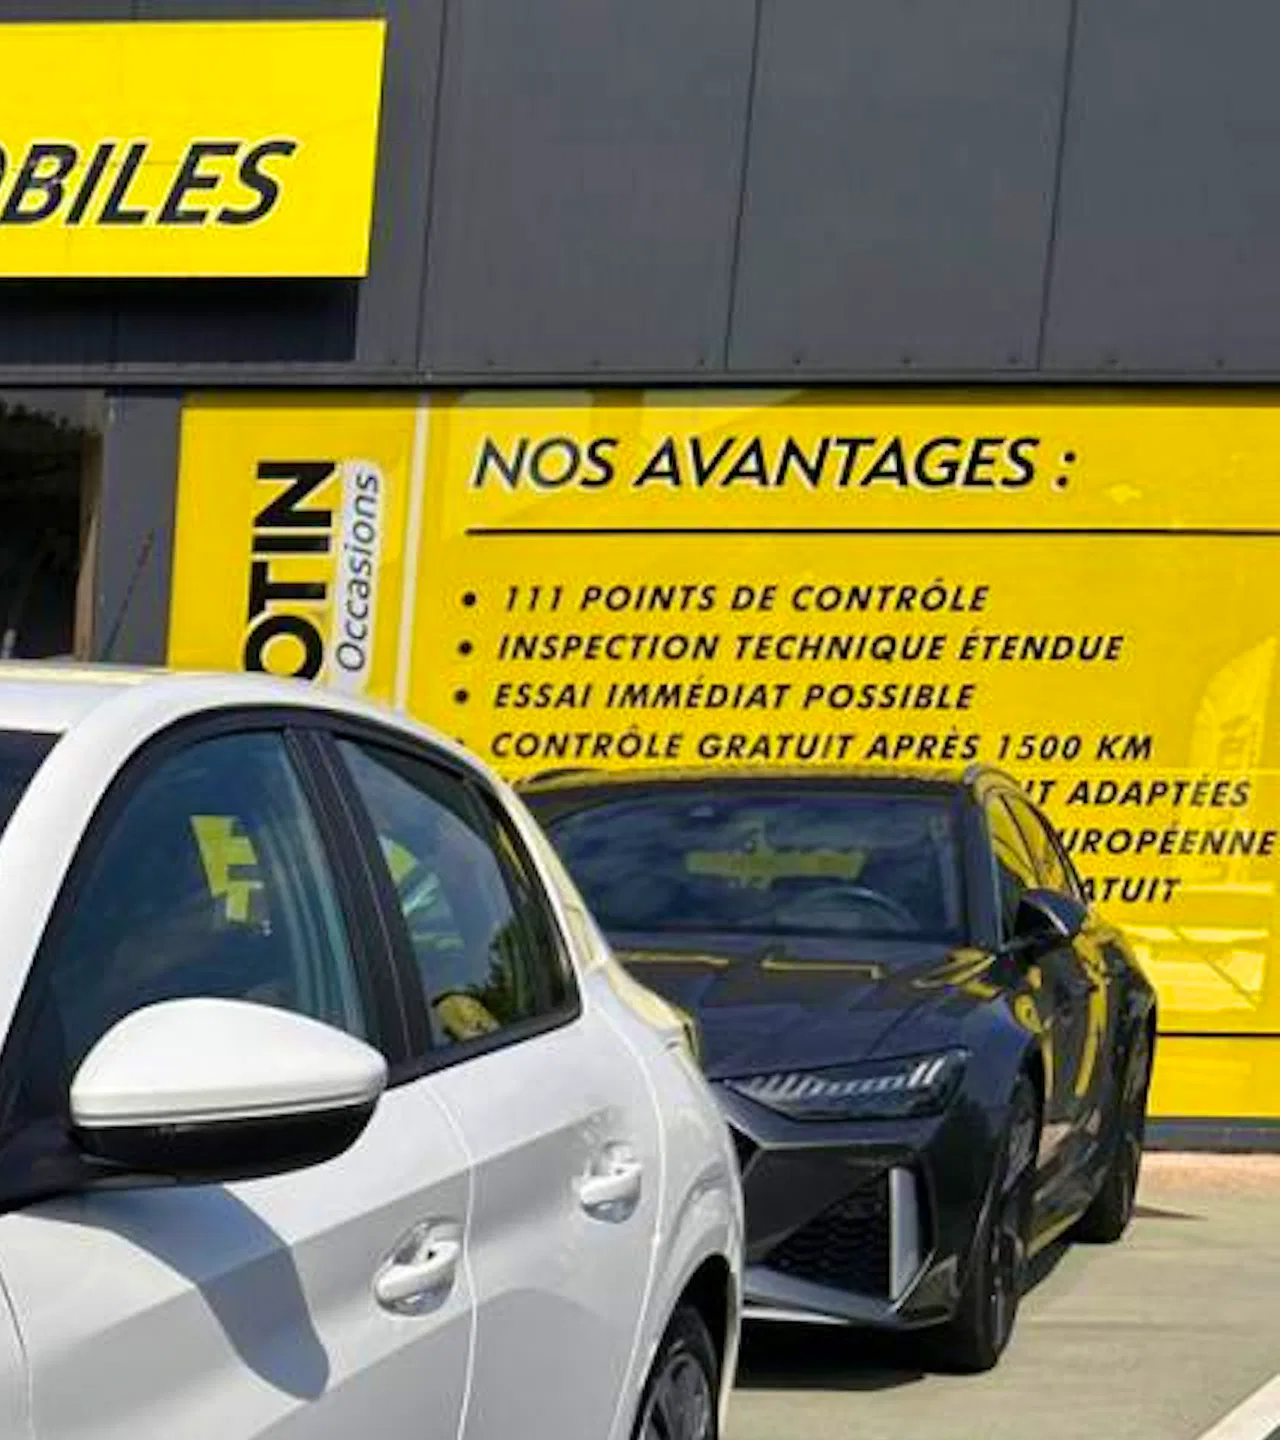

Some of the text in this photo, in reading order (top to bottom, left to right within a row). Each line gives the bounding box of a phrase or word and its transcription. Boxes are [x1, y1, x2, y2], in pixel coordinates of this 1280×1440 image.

[474, 437, 620, 489] NOS
[632, 436, 1041, 488] AVANTAGES
[337, 472, 379, 671] Occasions
[506, 577, 989, 612] 111 POINTS DE CONTRÔLE
[498, 627, 1124, 662] INSPECTION TECHNIQUE ÉTENDUE
[494, 675, 975, 710] ESSAI IMMÉDIAT POSSIBLE
[490, 724, 1153, 761] CONTRÔLE GRATUIT APRÈS 1500 KM
[1066, 774, 1251, 807] ADAPTÉES
